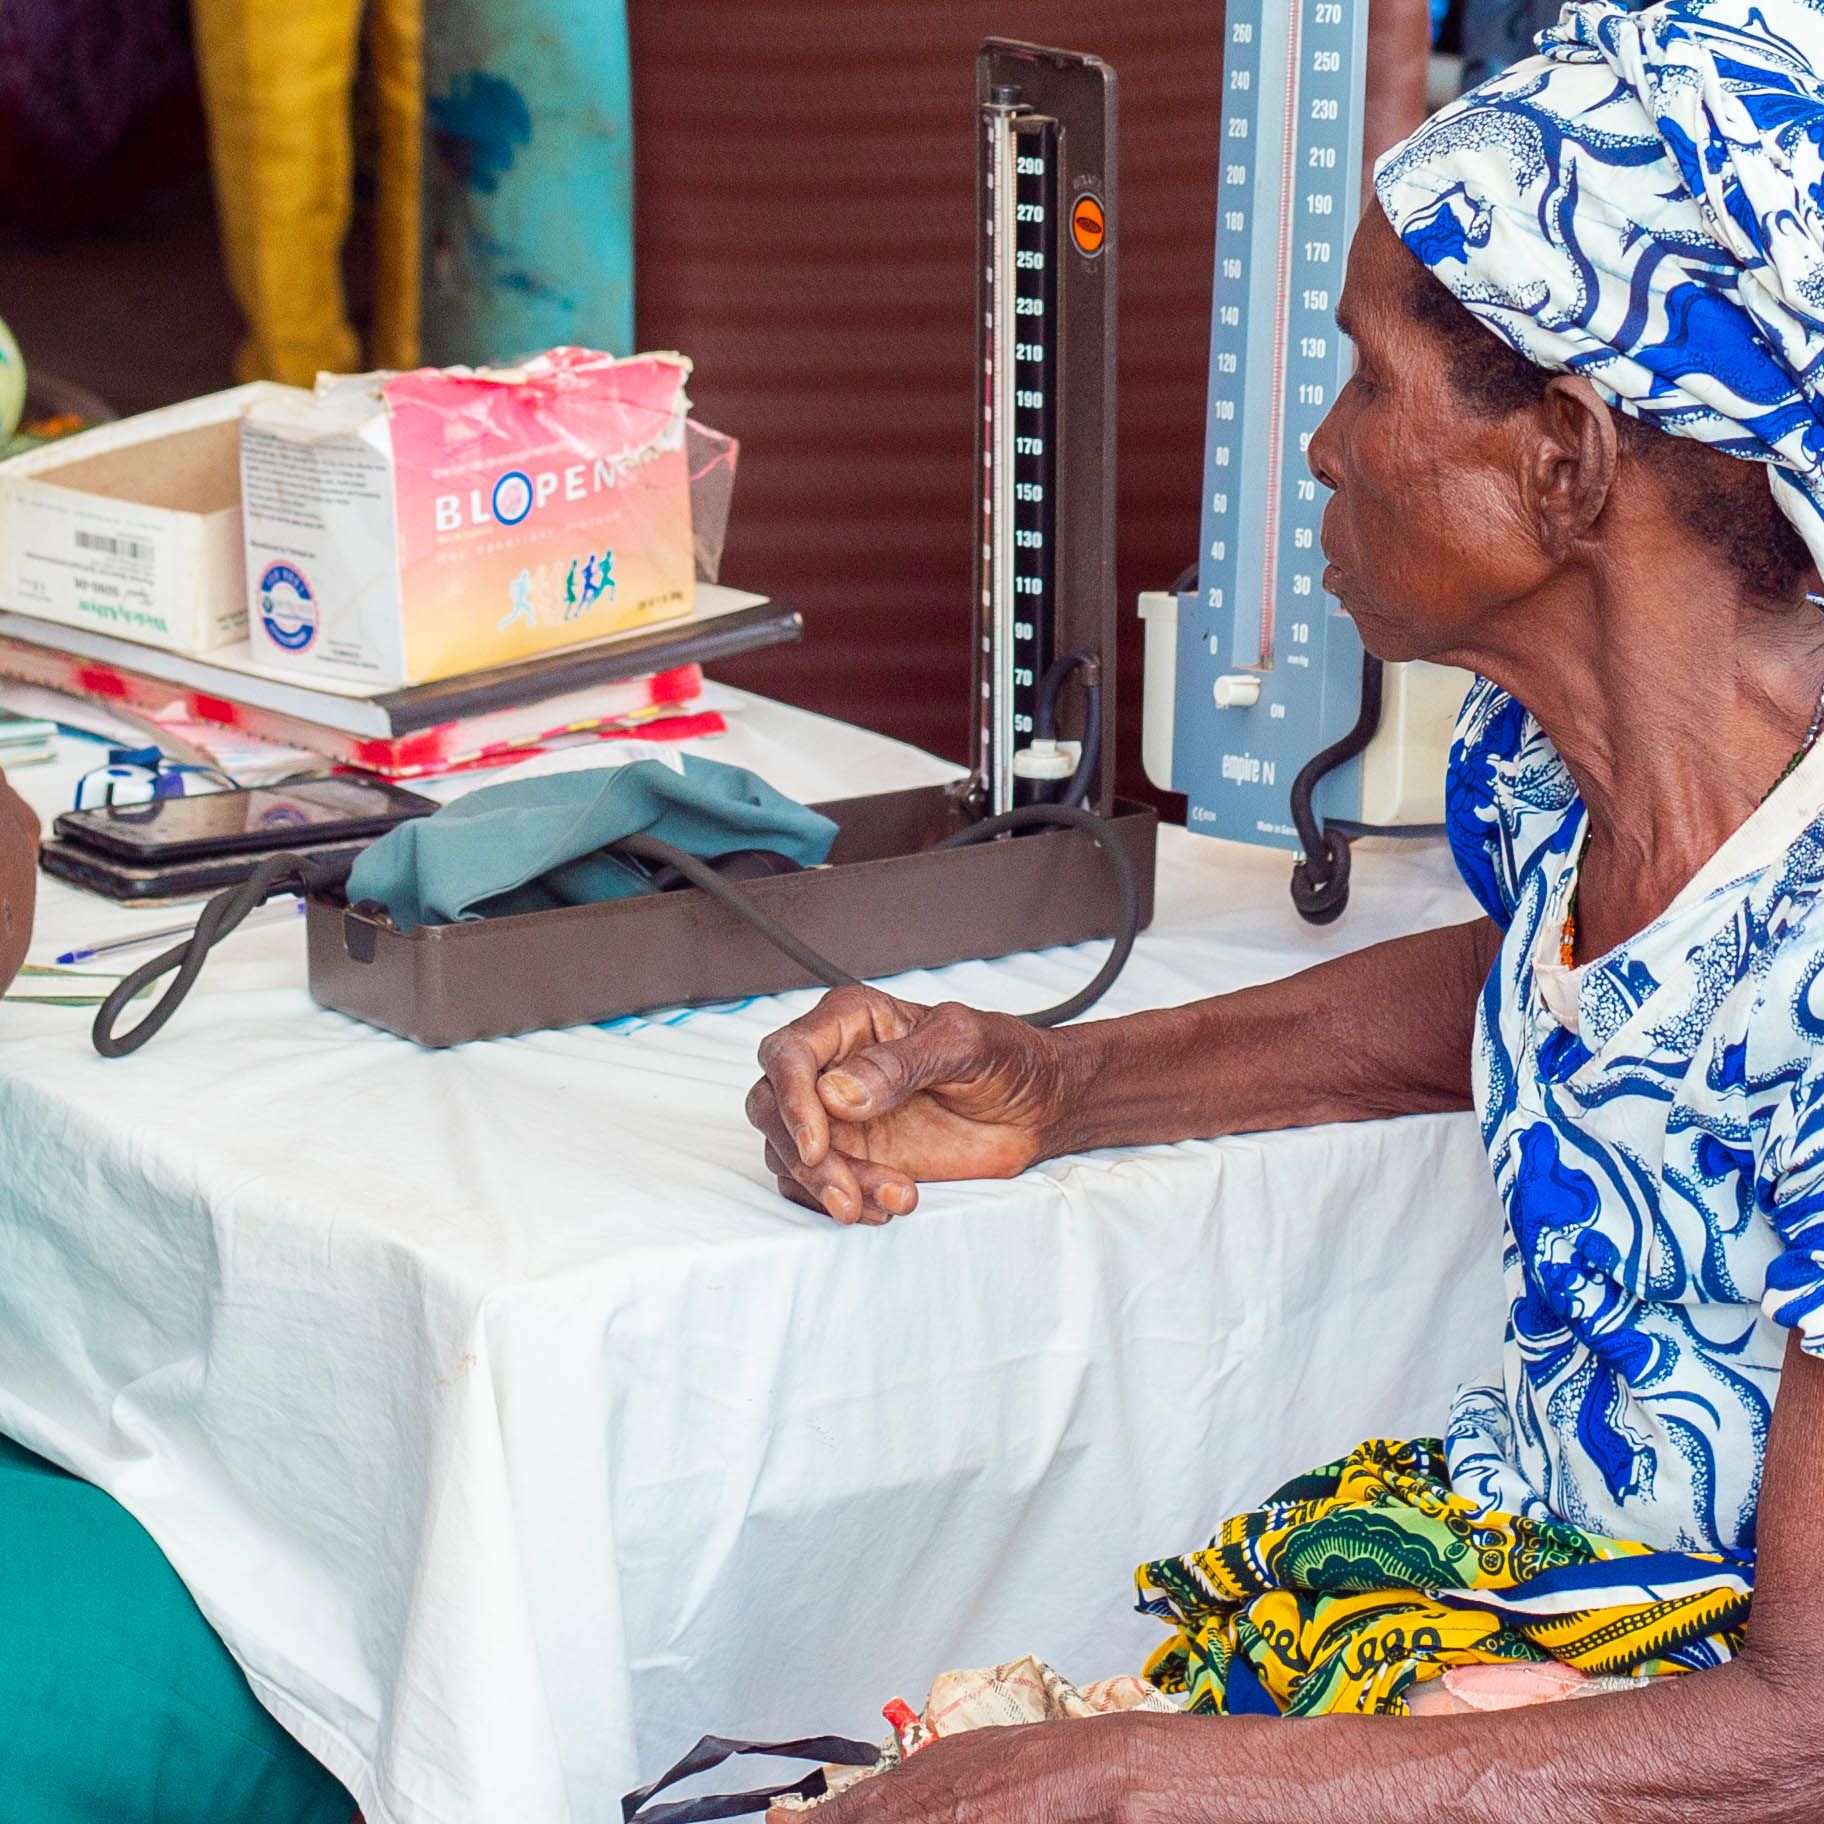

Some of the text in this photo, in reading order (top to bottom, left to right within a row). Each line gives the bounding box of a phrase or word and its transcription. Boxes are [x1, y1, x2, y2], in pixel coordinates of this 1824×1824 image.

[1315, 4, 1341, 24] 270
[1233, 23, 1252, 43] 260
[1313, 52, 1339, 72] 250
[1231, 70, 1250, 91] 240
[1311, 99, 1337, 120] 230
[1229, 118, 1248, 138] 220
[1016, 156, 1045, 175] 290
[1309, 147, 1335, 168] 210
[1227, 165, 1246, 185] 200
[1016, 204, 1045, 222] 270
[1306, 194, 1332, 215] 190
[1225, 211, 1243, 231] 180
[1016, 251, 1044, 270] 250
[1305, 242, 1331, 262] 170
[1223, 259, 1242, 279] 160
[1016, 298, 1044, 316] 230
[1303, 290, 1328, 310] 150
[1220, 306, 1239, 326] 140
[1016, 344, 1043, 362] 210
[1300, 338, 1326, 358] 130
[1218, 353, 1237, 373] 120
[1016, 390, 1043, 409] 190
[1299, 385, 1324, 405] 110
[1215, 400, 1234, 420] 100
[1016, 437, 1043, 456] 170
[1215, 447, 1230, 466] 80
[1016, 483, 1043, 502] 150
[1297, 480, 1315, 501] 70
[1213, 493, 1227, 513] 60
[1016, 530, 1042, 549] 130
[1295, 528, 1313, 548] 50
[1211, 541, 1225, 561] 40
[1016, 576, 1042, 595] 110
[1293, 575, 1311, 595] 30
[1209, 588, 1223, 608] 20
[1015, 622, 1033, 640] 90
[1291, 623, 1309, 643] 10
[1209, 635, 1218, 654] 0
[1015, 668, 1033, 686] 70
[1270, 703, 1285, 719] ON
[1015, 715, 1033, 733] 50
[1222, 752, 1275, 786] empire N
